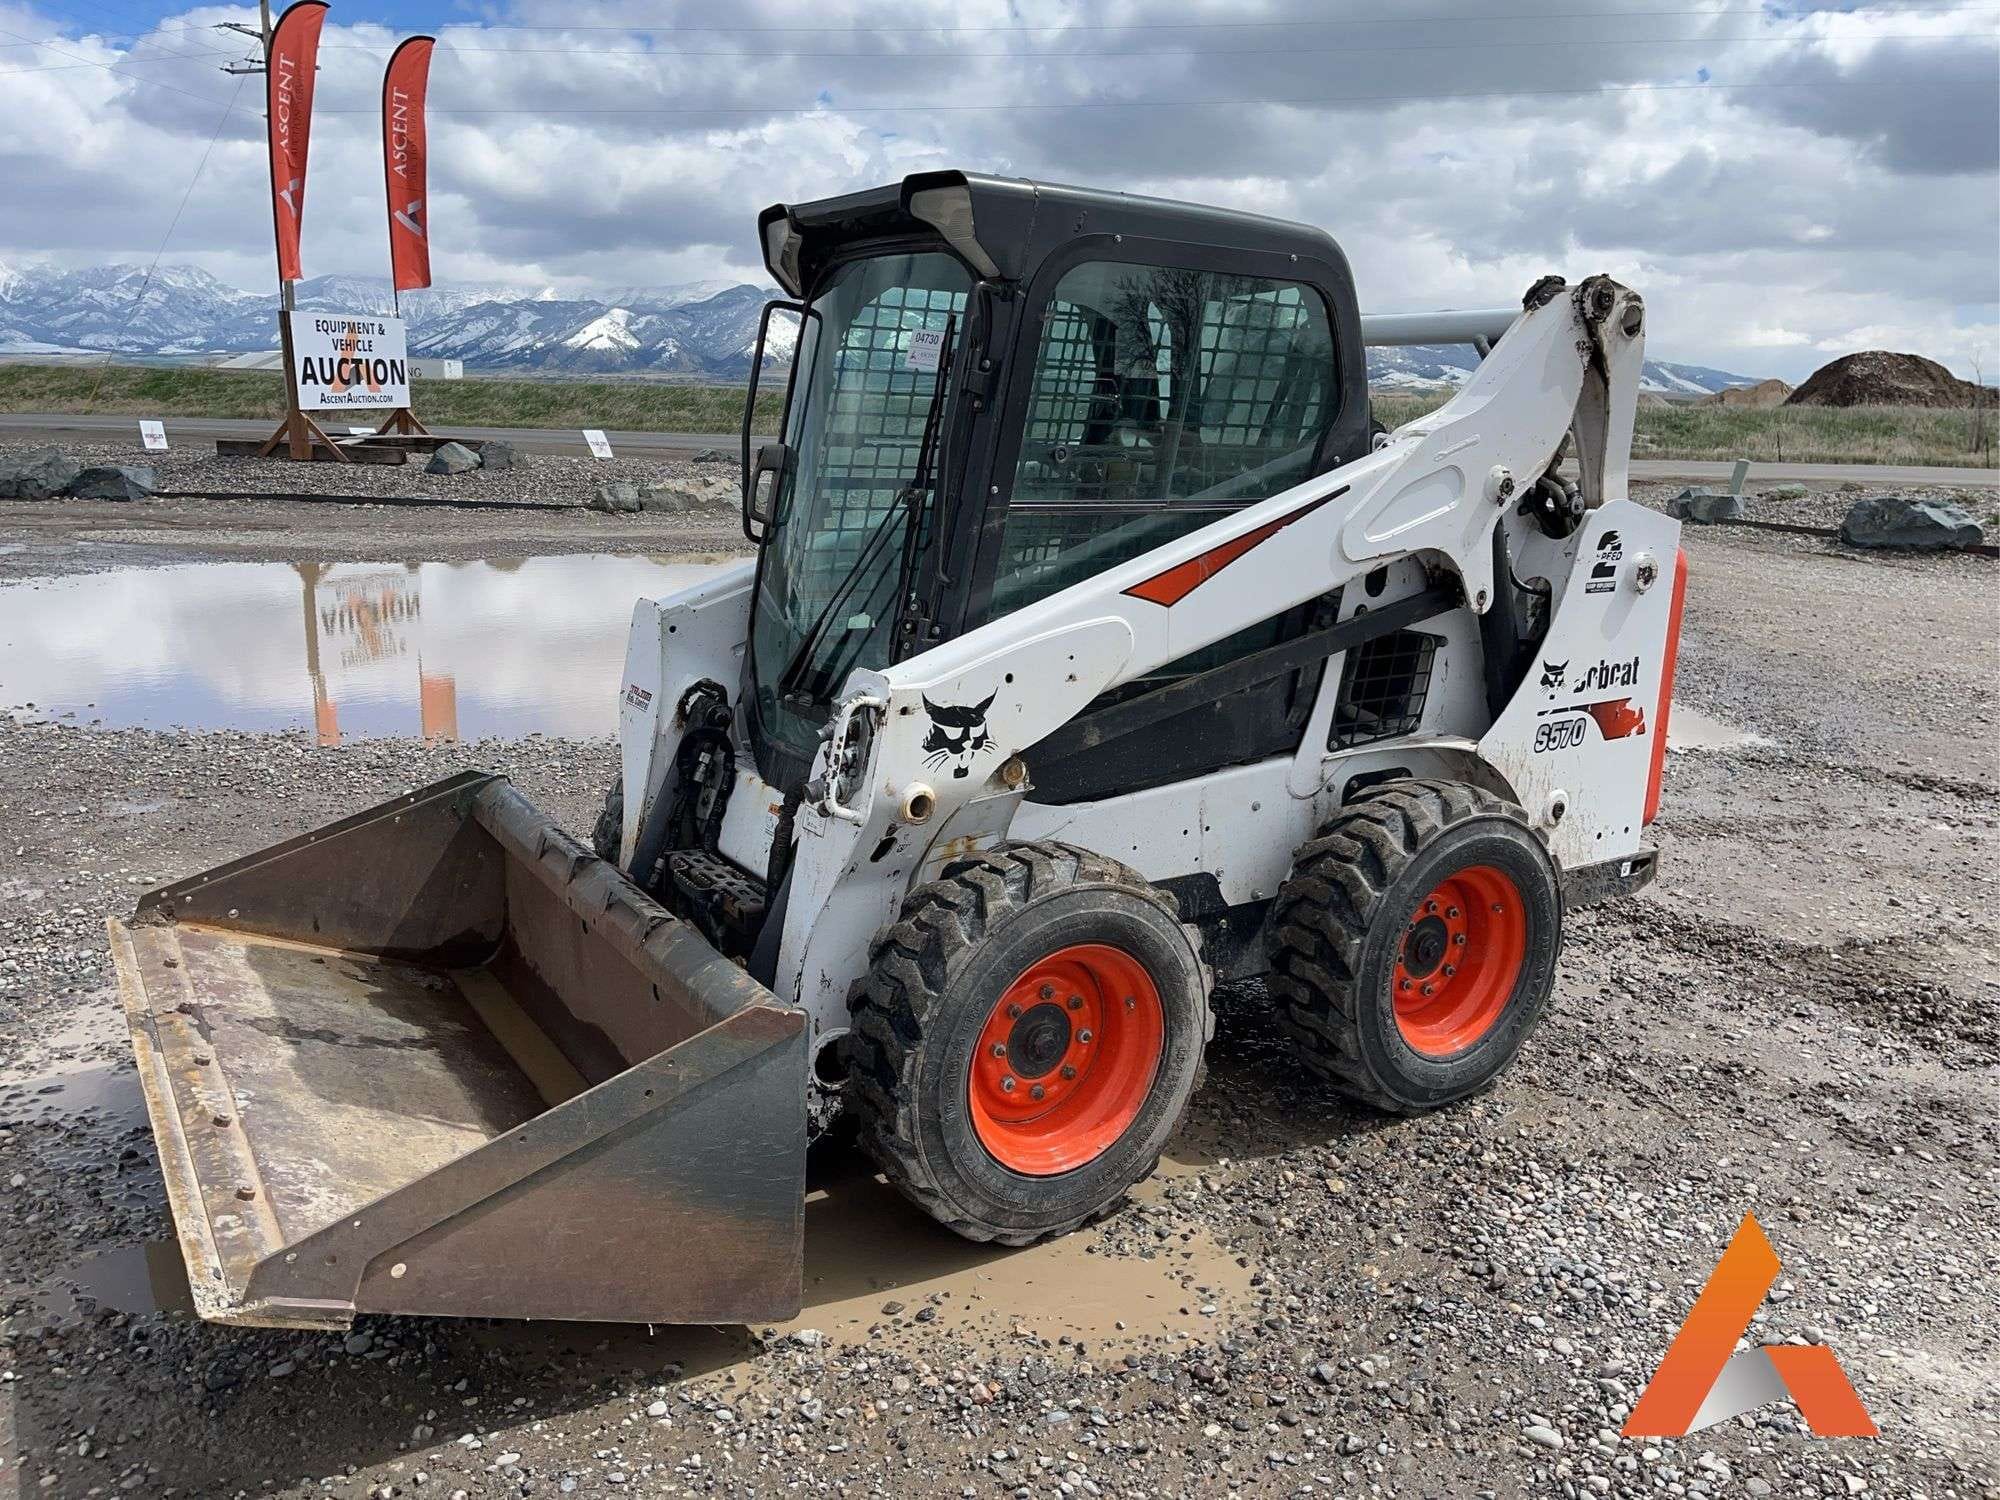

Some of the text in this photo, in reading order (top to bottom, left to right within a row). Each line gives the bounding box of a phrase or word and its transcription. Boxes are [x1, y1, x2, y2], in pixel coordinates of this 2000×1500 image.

[278, 53, 295, 156] ASCENT
[392, 86, 409, 179] ASCENT
[315, 319, 386, 336] EQUIPMENT &
[915, 332, 939, 345] 04730
[332, 338, 373, 352] VEHICLE
[301, 356, 406, 386] AUCTION
[1596, 551, 1622, 561] PEED
[1534, 717, 1587, 753] S570
